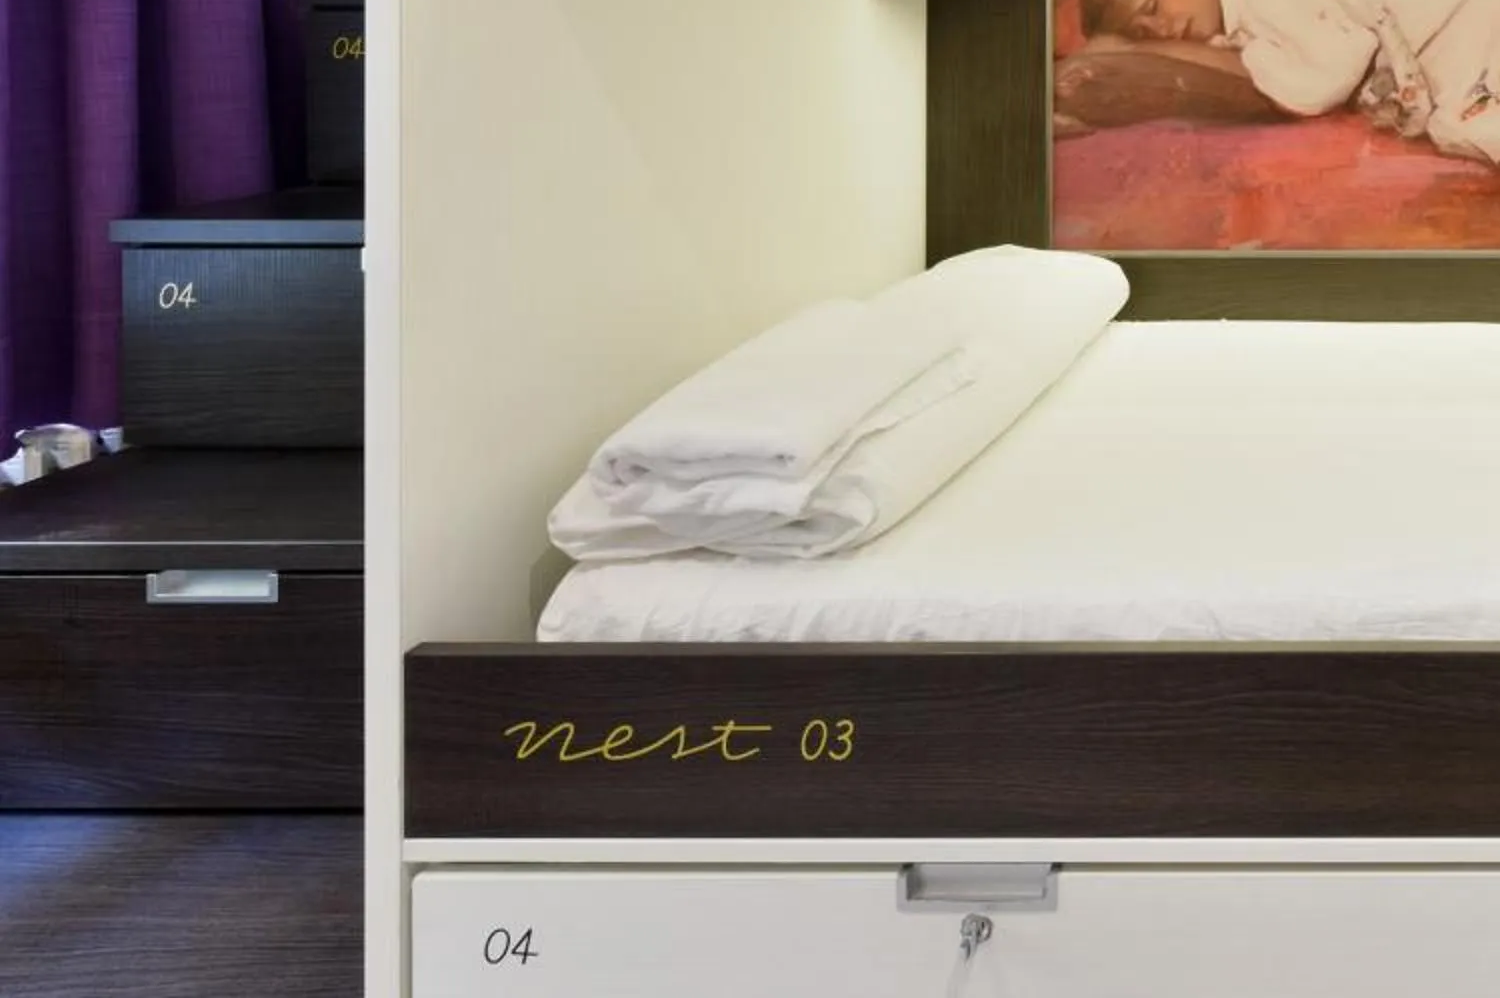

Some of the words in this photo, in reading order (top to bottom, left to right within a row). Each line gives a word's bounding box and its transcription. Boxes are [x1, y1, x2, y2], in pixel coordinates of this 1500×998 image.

[333, 36, 364, 59] 04
[159, 282, 197, 309] 04
[504, 718, 773, 762] nest
[801, 718, 856, 762] 03
[484, 927, 539, 965] 04
